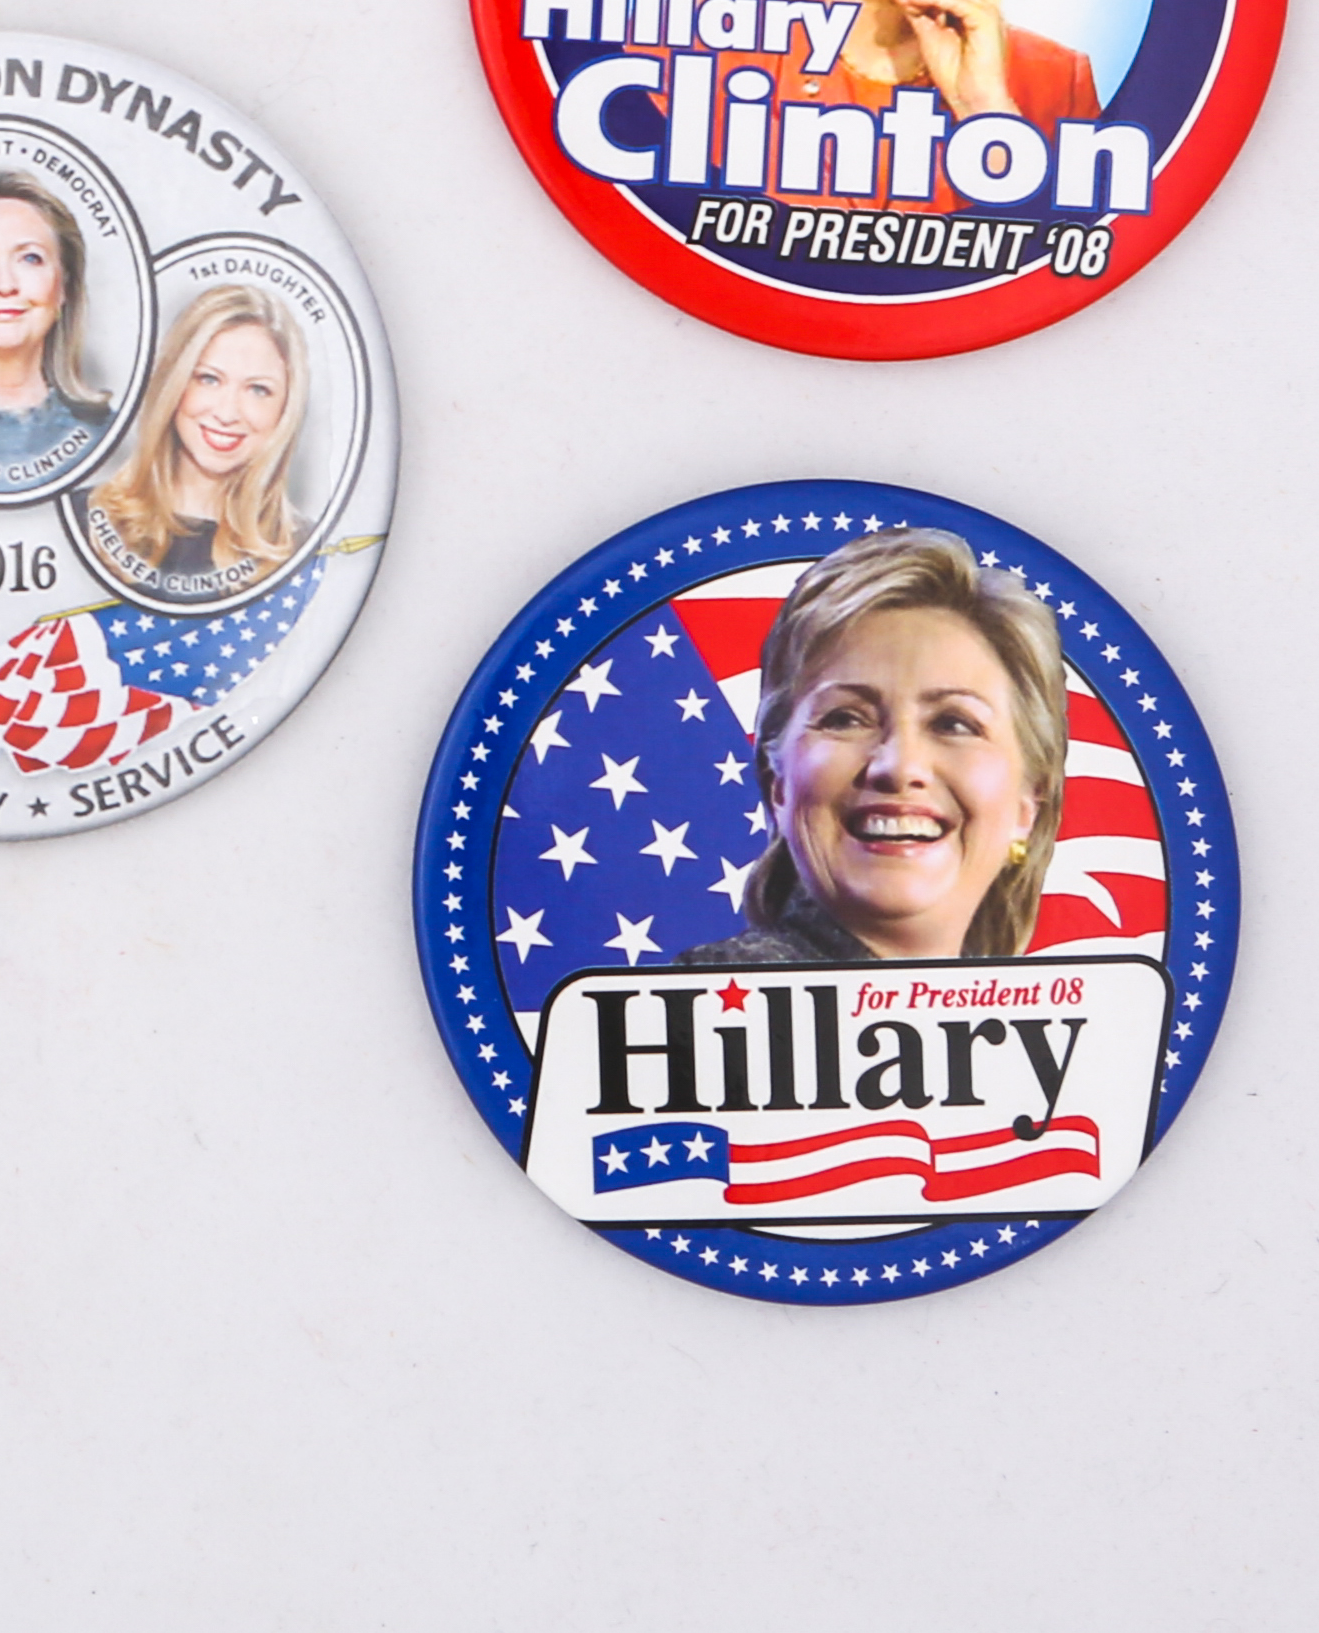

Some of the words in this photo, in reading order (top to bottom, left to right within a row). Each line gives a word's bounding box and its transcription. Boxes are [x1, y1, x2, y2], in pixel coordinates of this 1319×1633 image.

[57, 63, 303, 218] DYNASTY
[554, 54, 1153, 214] Clinton
[32, 148, 119, 240] DEMOCRAT
[690, 199, 772, 246] FOR
[781, 208, 1031, 273] PRESIDENT
[189, 264, 218, 281] 1st
[225, 258, 325, 324] DAUGHTER
[8, 429, 90, 482] CLINTON
[89, 508, 159, 587] CHELSEA
[165, 560, 255, 594] CLINTON
[70, 712, 246, 818] SERVICE
[851, 984, 899, 1018] for
[907, 980, 1041, 1010] President
[1049, 977, 1084, 1006] 08
[582, 977, 1086, 1142] Hillary
